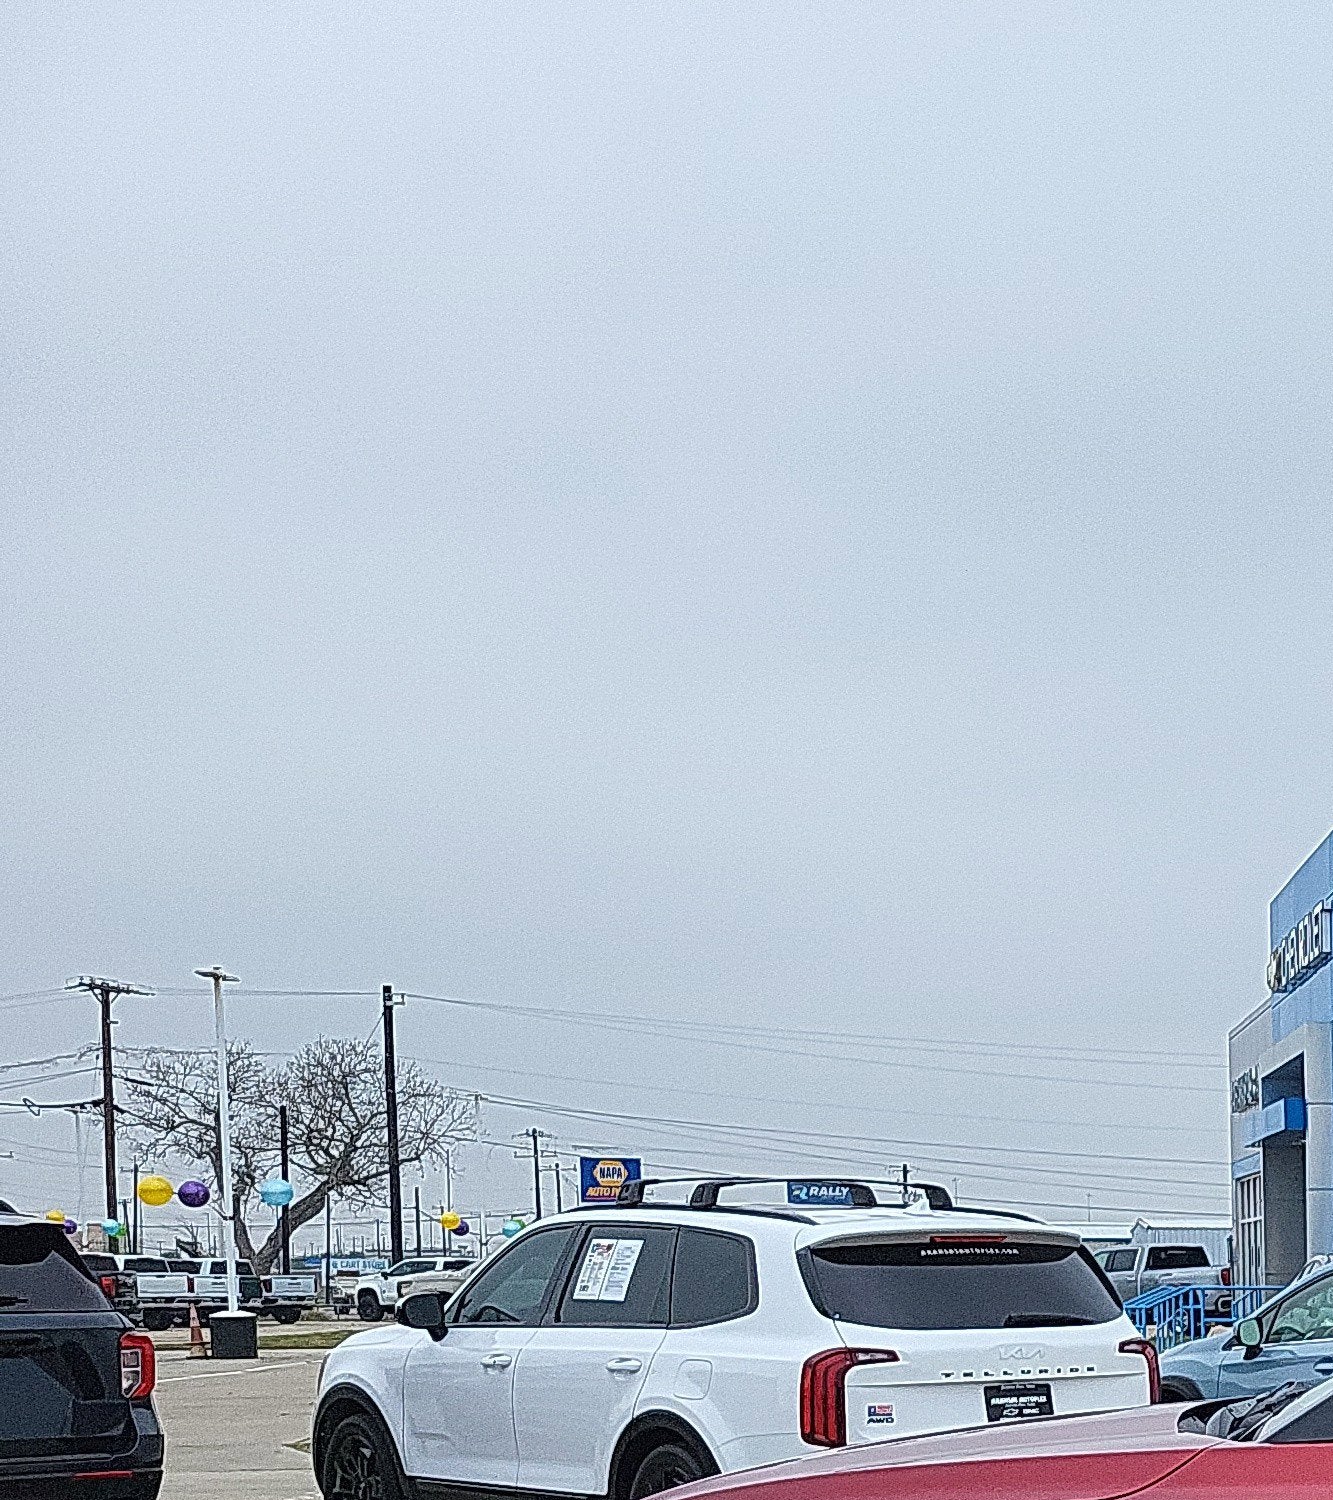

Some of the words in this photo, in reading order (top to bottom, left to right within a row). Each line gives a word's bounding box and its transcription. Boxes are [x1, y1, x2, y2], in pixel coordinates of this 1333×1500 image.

[600, 1167, 622, 1179] NAPA
[586, 1187, 611, 1197] AUTO
[809, 1186, 849, 1199] RALLY
[941, 1366, 1095, 1378] TELLURIDE
